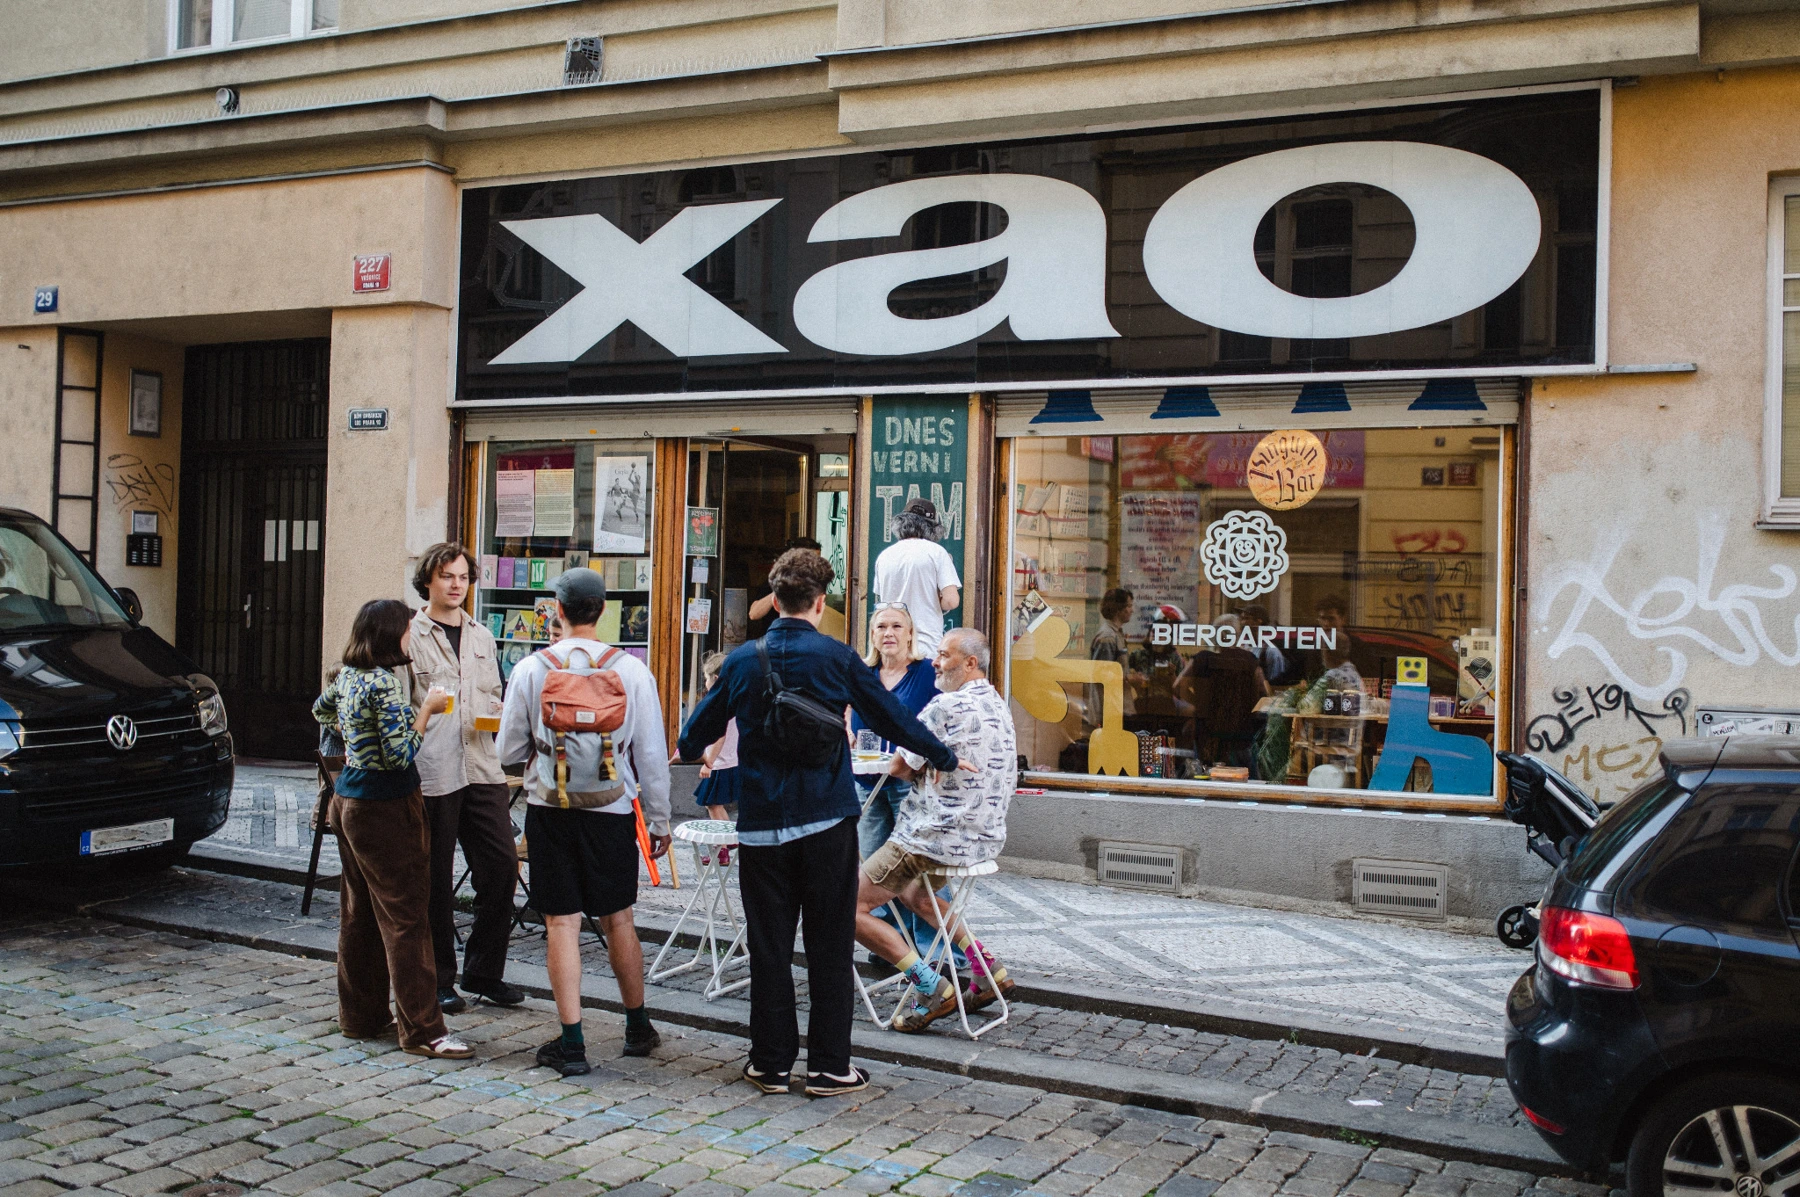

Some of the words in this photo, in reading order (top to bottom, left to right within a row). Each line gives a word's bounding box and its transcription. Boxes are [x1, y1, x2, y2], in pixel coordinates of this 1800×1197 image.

[359, 256, 384, 274] 227
[486, 141, 1542, 366] xao
[37, 291, 53, 307] 29
[885, 415, 956, 447] DNES
[1274, 467, 1316, 506] Bar
[875, 481, 963, 543] TM
[1152, 623, 1337, 650] BIERGARTEN
[81, 844, 90, 852] CZ
